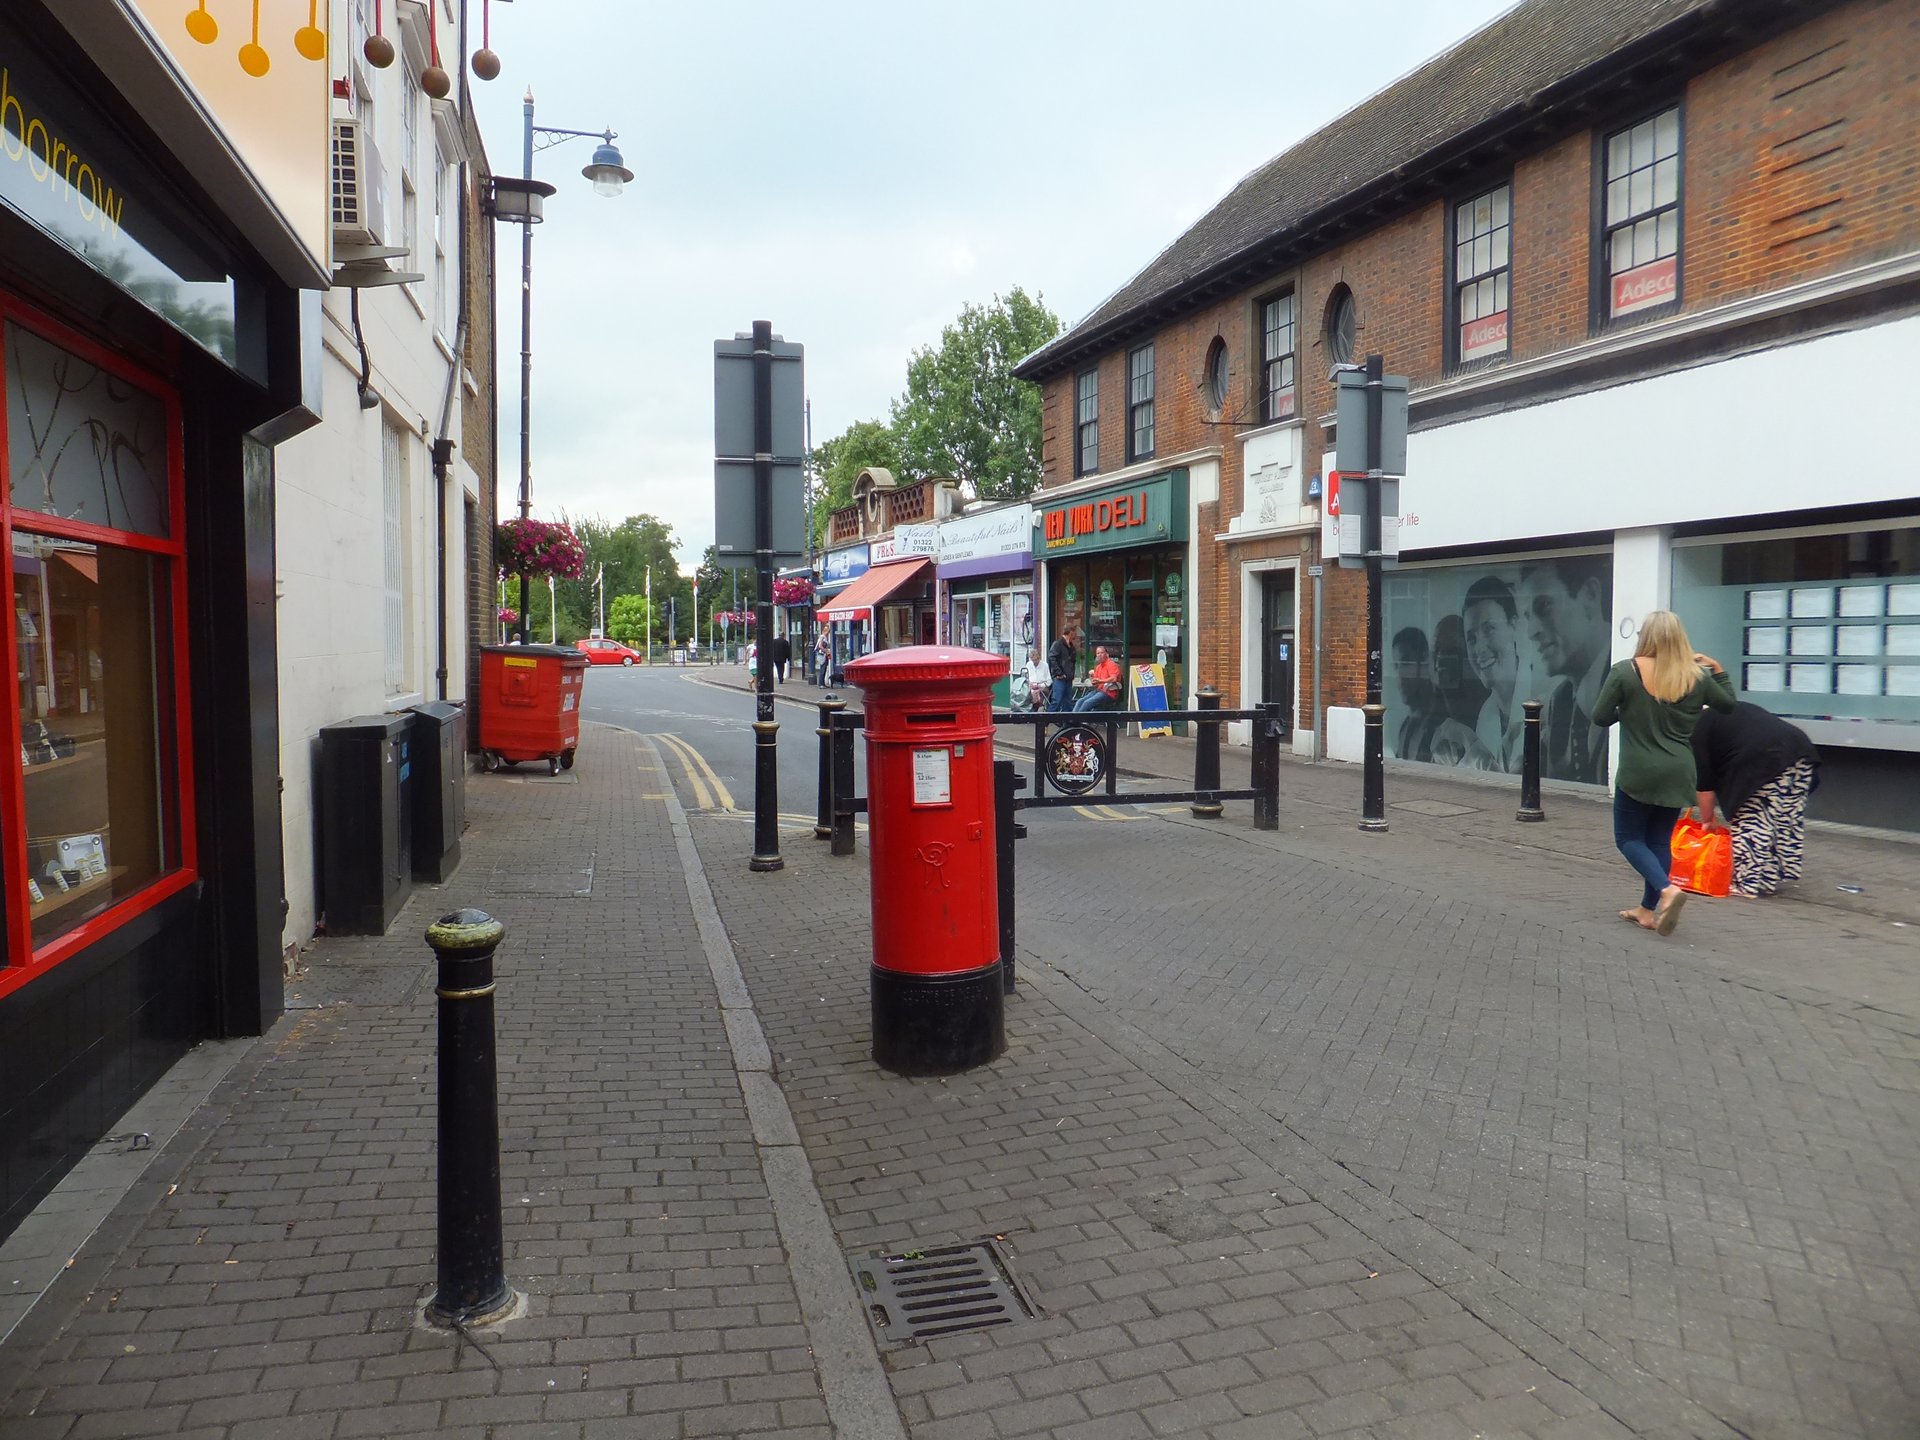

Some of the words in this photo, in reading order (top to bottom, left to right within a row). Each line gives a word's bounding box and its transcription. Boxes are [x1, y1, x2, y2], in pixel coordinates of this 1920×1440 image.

[0, 67, 123, 241] borrow
[1045, 509, 1065, 540] NEW
[1068, 503, 1094, 535] YORK
[1097, 492, 1147, 531] DELI
[1407, 513, 1420, 526] life
[899, 527, 934, 538] Nails
[947, 526, 993, 547] Beautiful
[991, 519, 1019, 538] Nails
